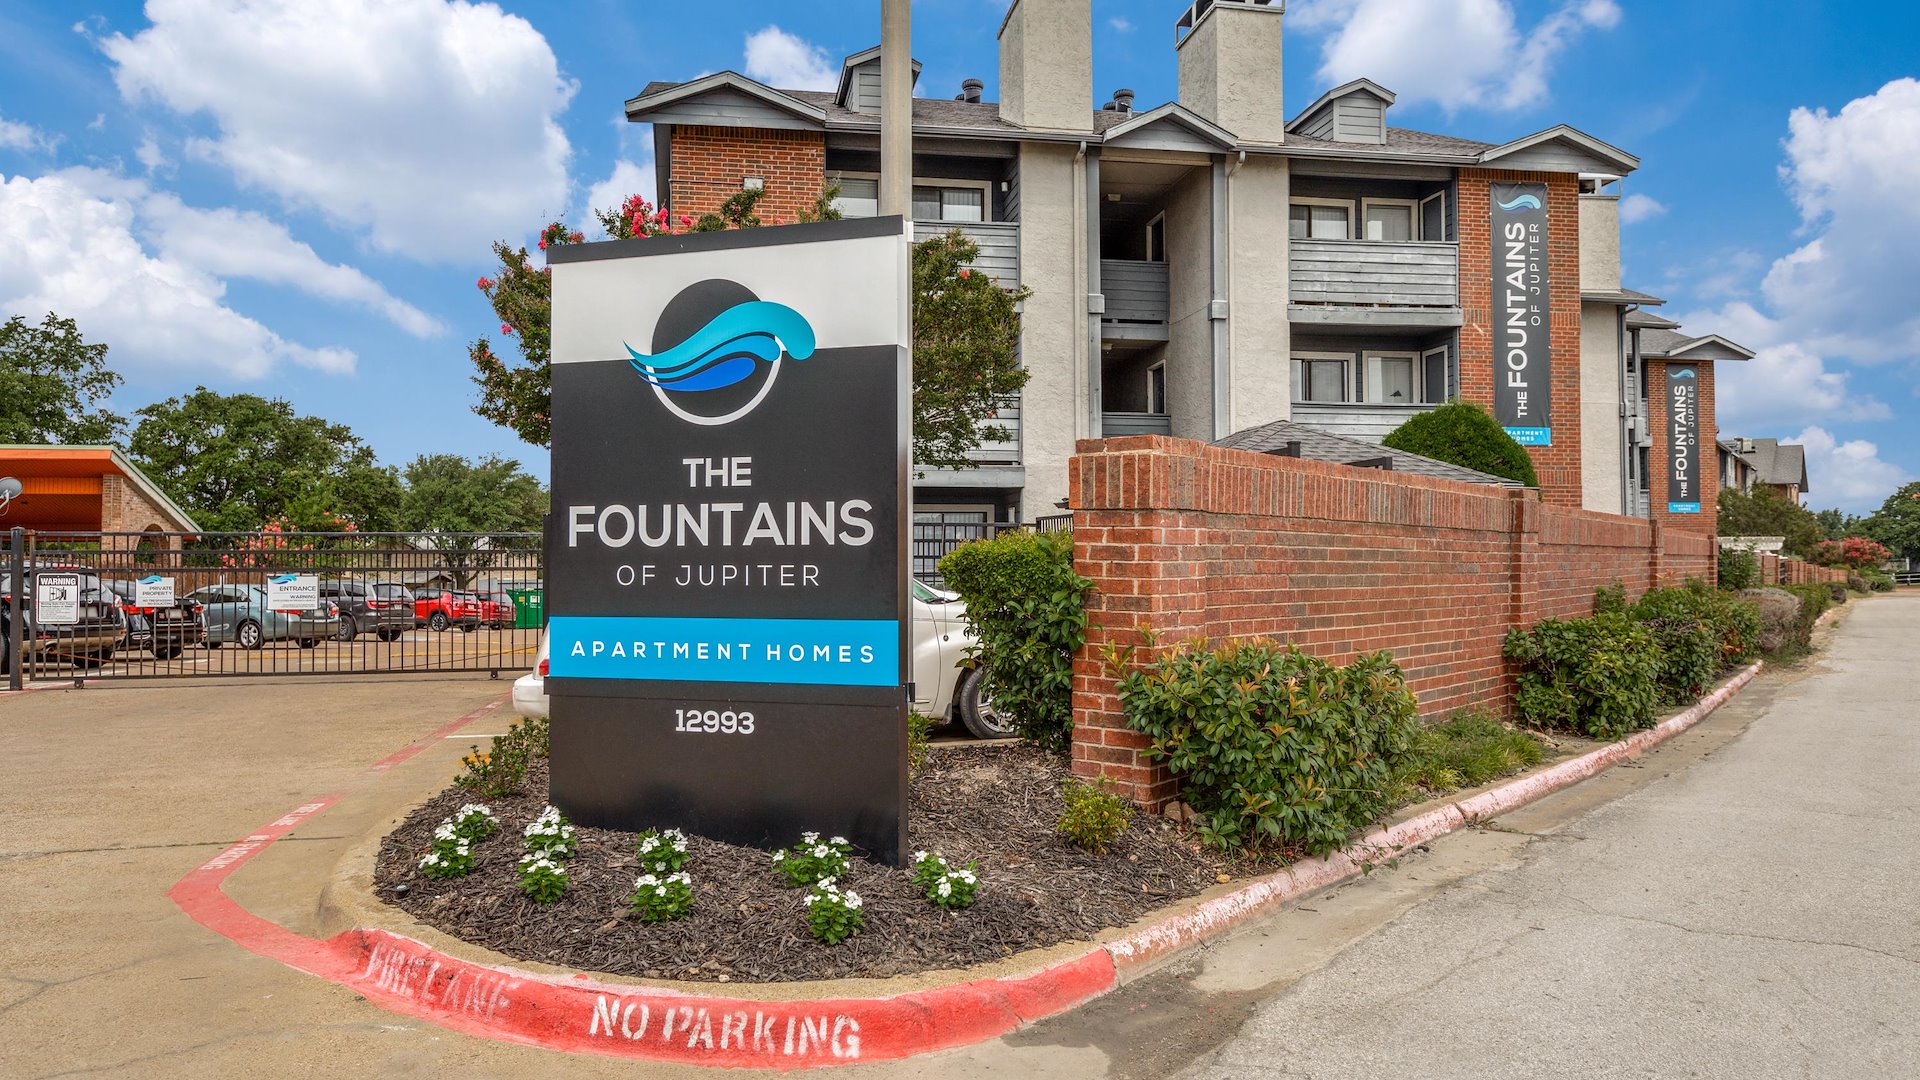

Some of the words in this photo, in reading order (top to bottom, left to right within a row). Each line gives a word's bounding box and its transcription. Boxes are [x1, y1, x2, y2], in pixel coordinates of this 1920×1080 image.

[1529, 223, 1540, 296] JUPITER
[1504, 222, 1528, 388] FOUNTAINS
[1530, 305, 1541, 326] OF
[1517, 391, 1528, 418] THE
[1674, 385, 1688, 480] FOUNTAINS
[1688, 432, 1695, 446] OF
[682, 456, 752, 488] THE
[568, 499, 875, 548] FOUNTAINS
[40, 577, 76, 585] WARNING
[616, 565, 656, 586] OF
[675, 564, 821, 587] JUPITER
[571, 640, 751, 660] APARTMENT
[766, 644, 875, 663] HOMES
[675, 709, 755, 735] 12993
[588, 996, 649, 1041] NO
[662, 1004, 860, 1058] PARKING
